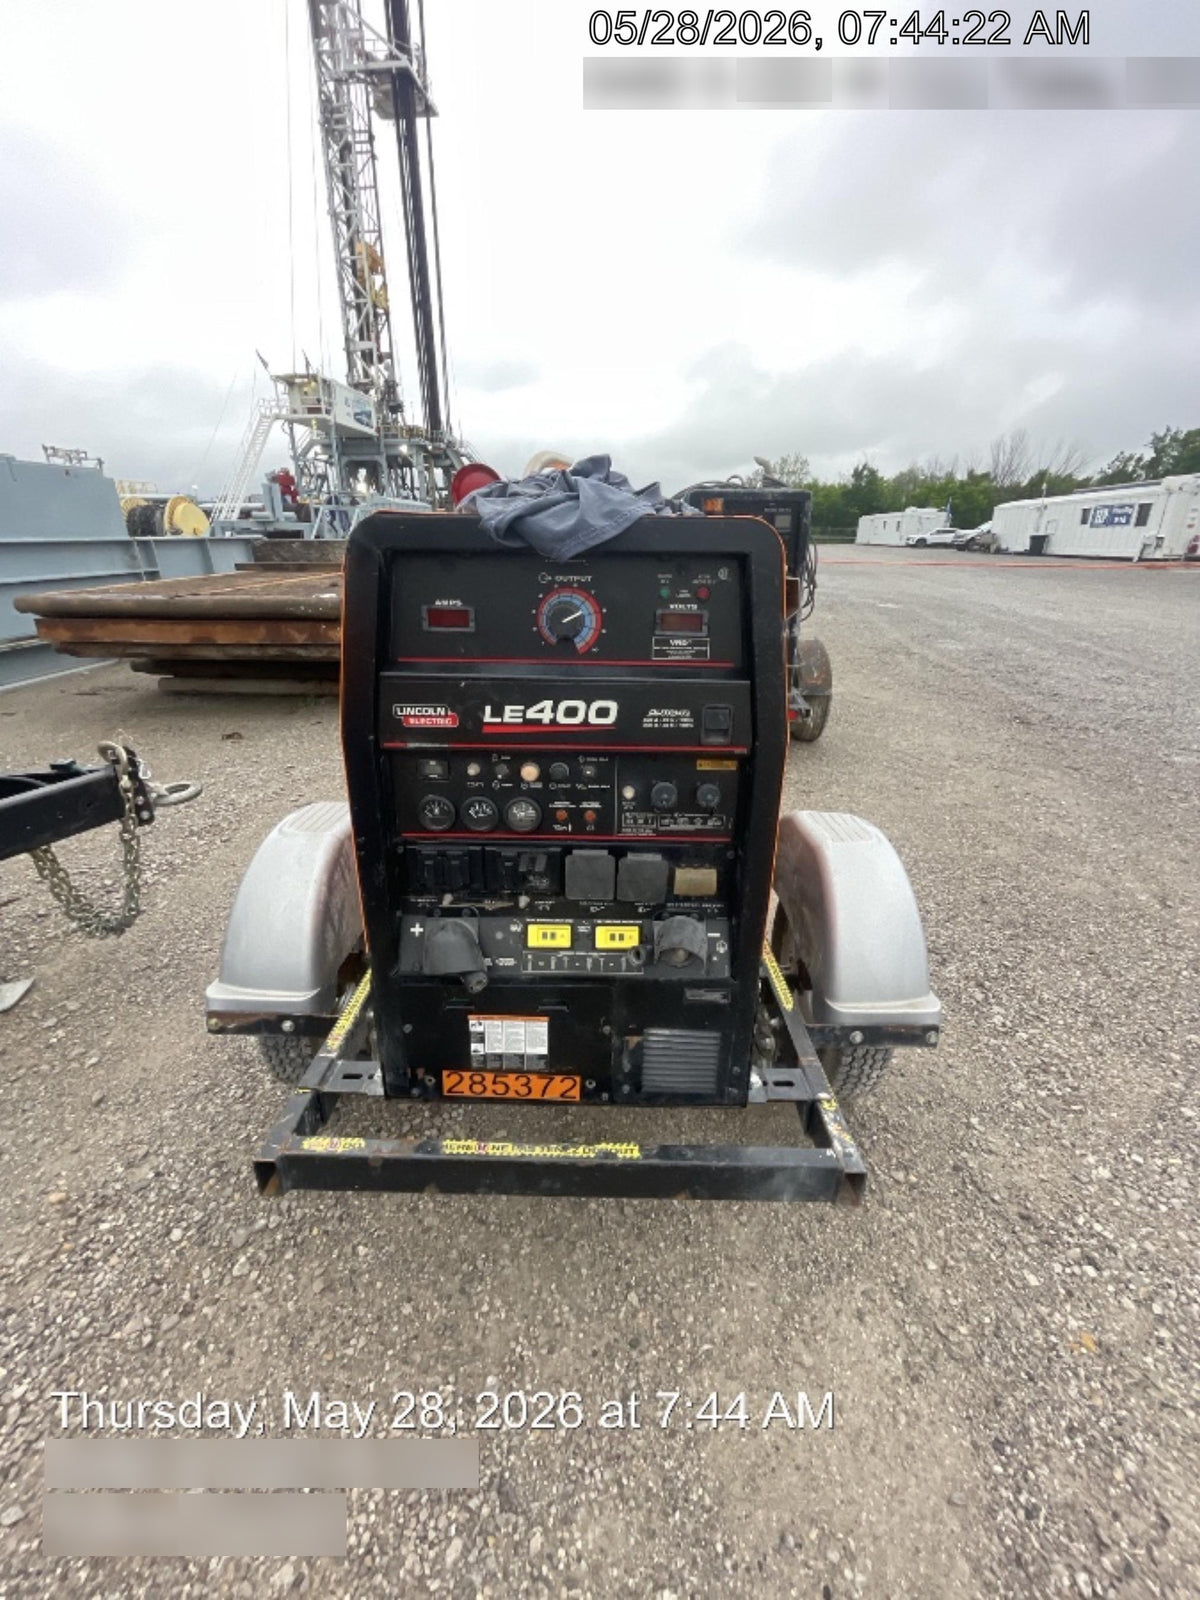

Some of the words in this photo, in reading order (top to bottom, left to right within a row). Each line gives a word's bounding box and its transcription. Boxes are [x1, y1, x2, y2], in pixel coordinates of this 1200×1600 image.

[396, 706, 445, 716] LINCOLN
[483, 699, 619, 725] LE400
[408, 717, 453, 725] ELECTRIC
[446, 1071, 577, 1099] 285372
